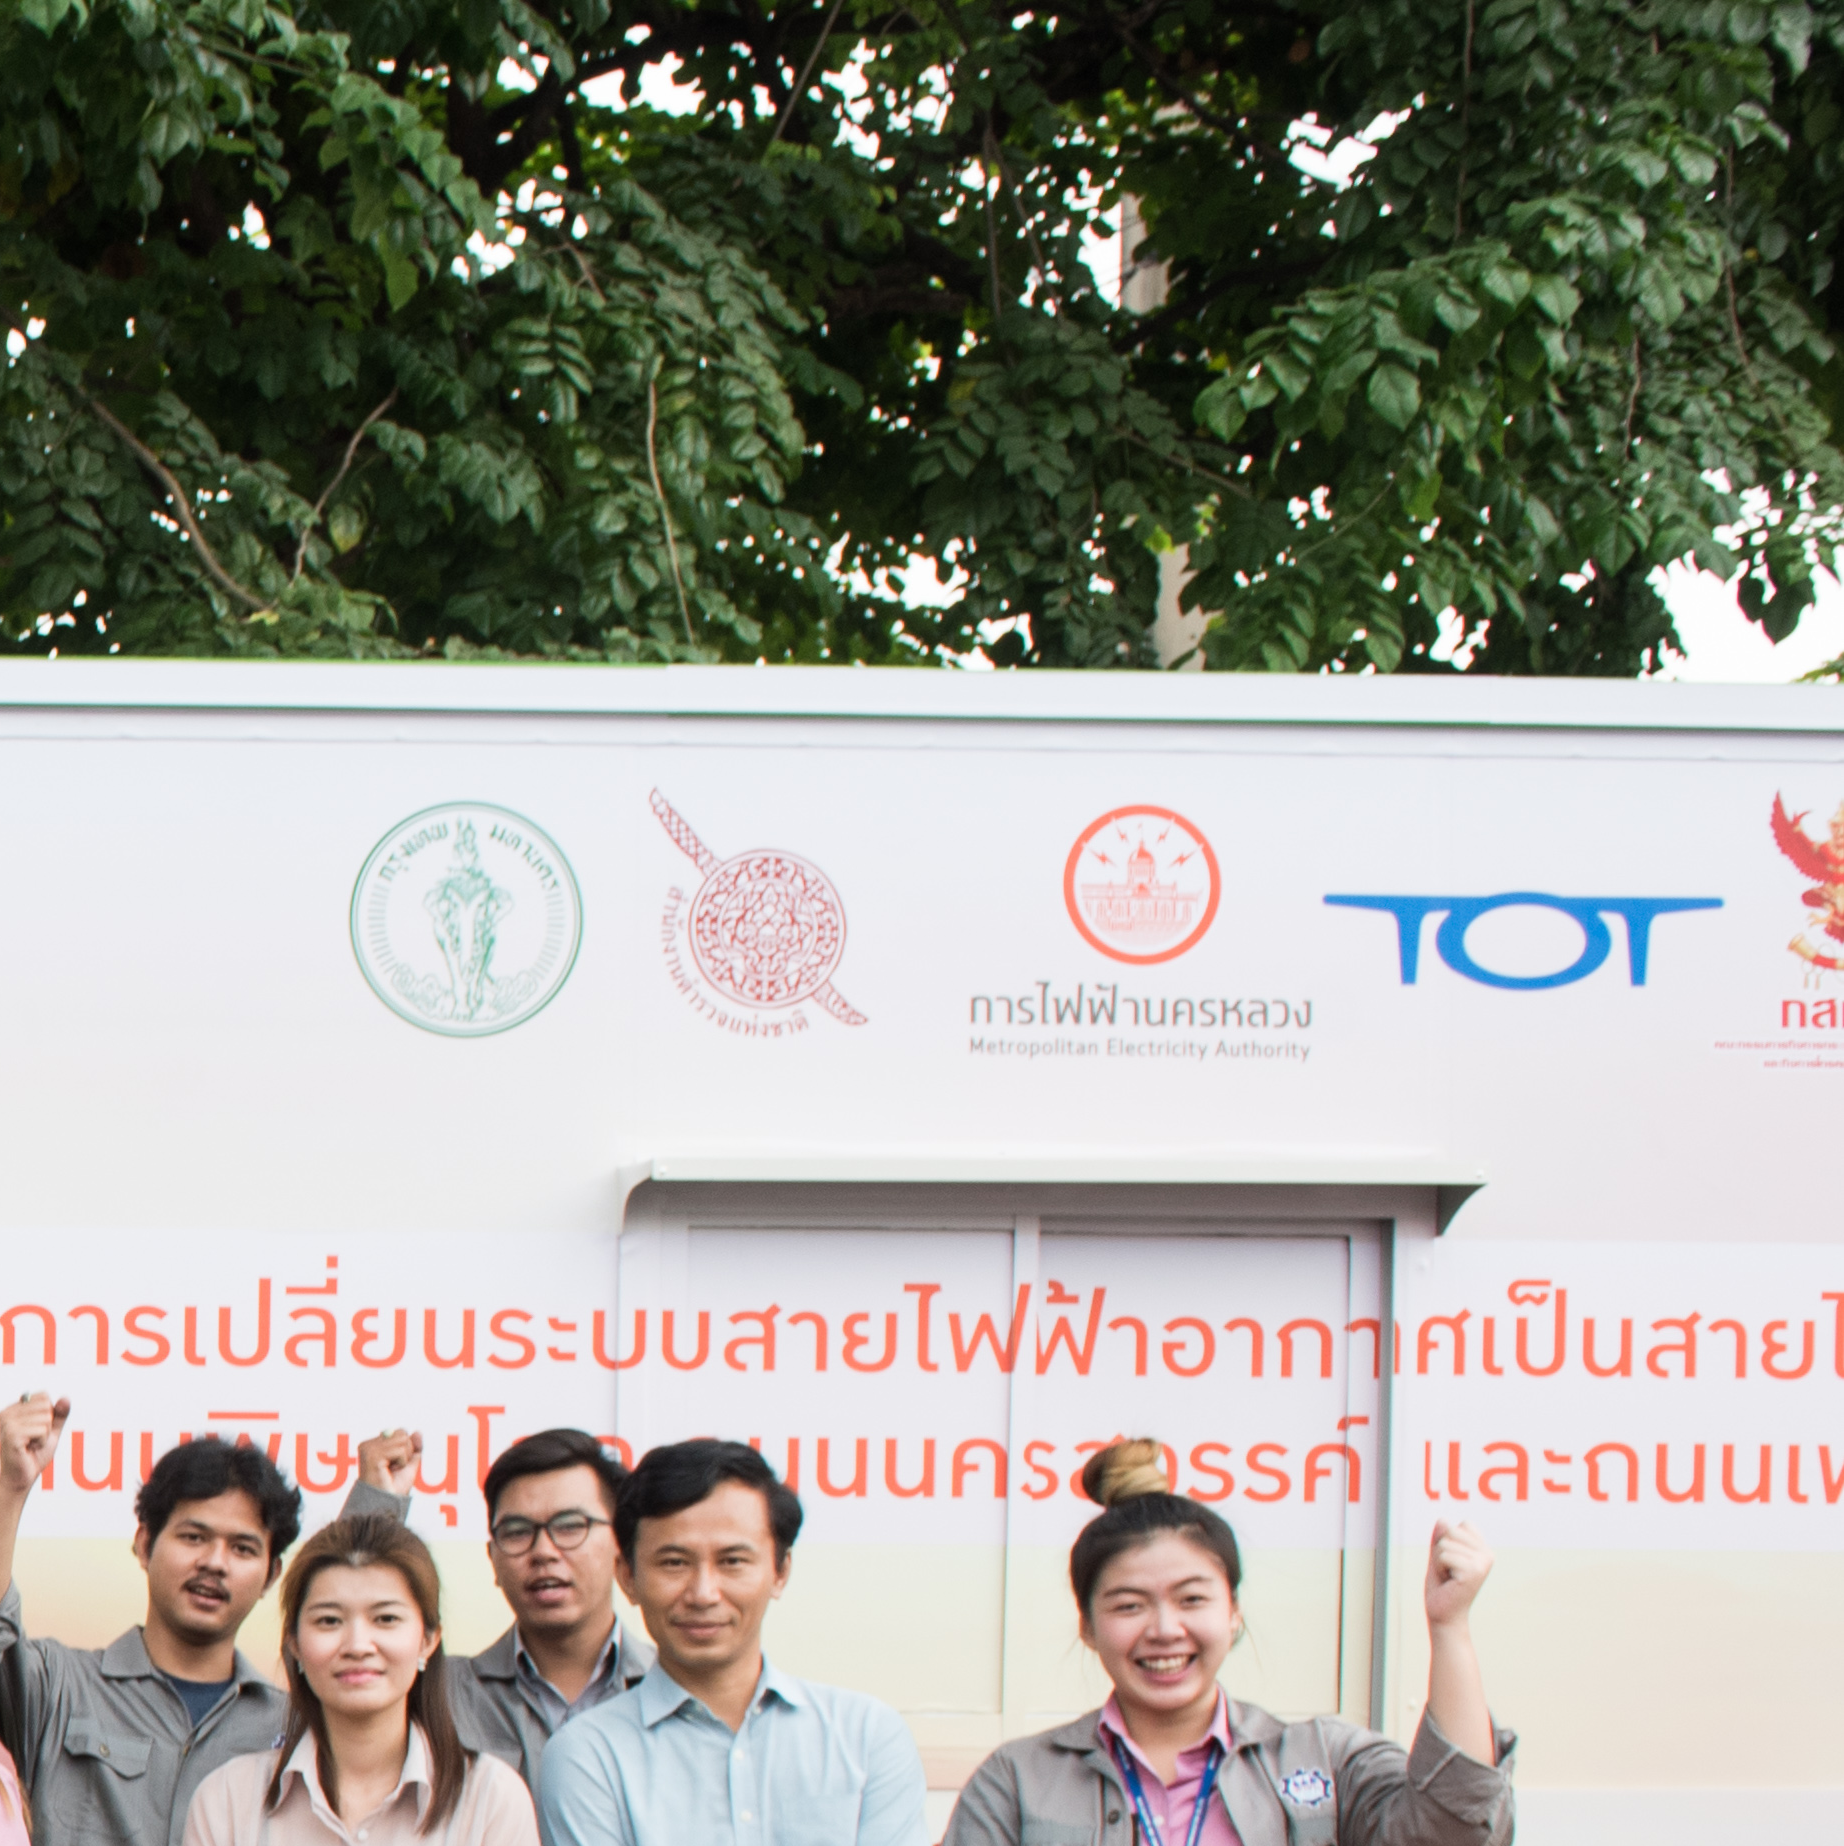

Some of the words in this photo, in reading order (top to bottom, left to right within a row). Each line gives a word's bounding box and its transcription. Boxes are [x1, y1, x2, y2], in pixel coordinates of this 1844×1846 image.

[1323, 892, 1724, 991] TOT
[969, 982, 1312, 1030] การไฟฟ้านครหลวง
[1781, 996, 1844, 1029] กส
[970, 1038, 1099, 1062] Metropolitan
[1107, 1038, 1208, 1062] Electricity
[1215, 1040, 1312, 1062] Authority
